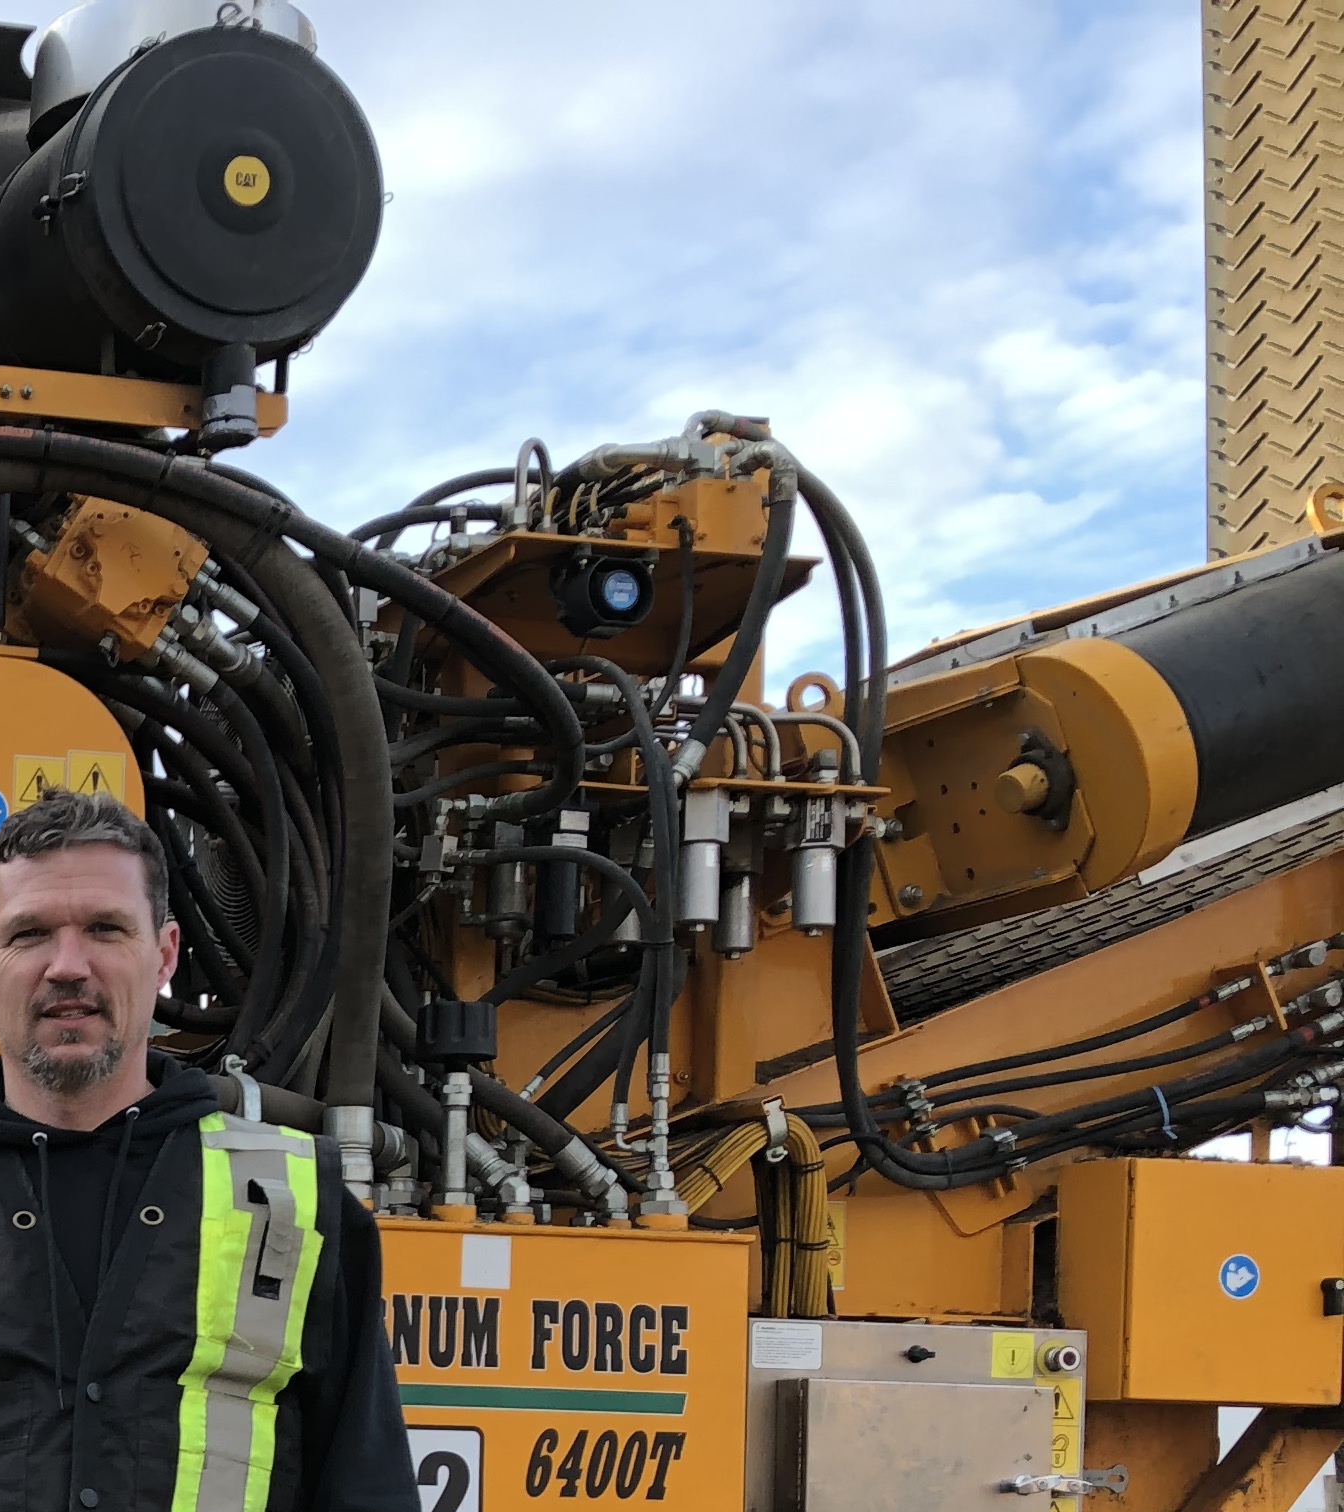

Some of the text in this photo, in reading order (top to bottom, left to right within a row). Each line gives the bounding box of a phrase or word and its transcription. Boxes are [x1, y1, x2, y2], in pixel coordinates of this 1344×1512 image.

[235, 171, 258, 188] CAT
[381, 1294, 501, 1369] NUM
[530, 1299, 690, 1376] FORCE
[526, 1428, 686, 1500] 6400T
